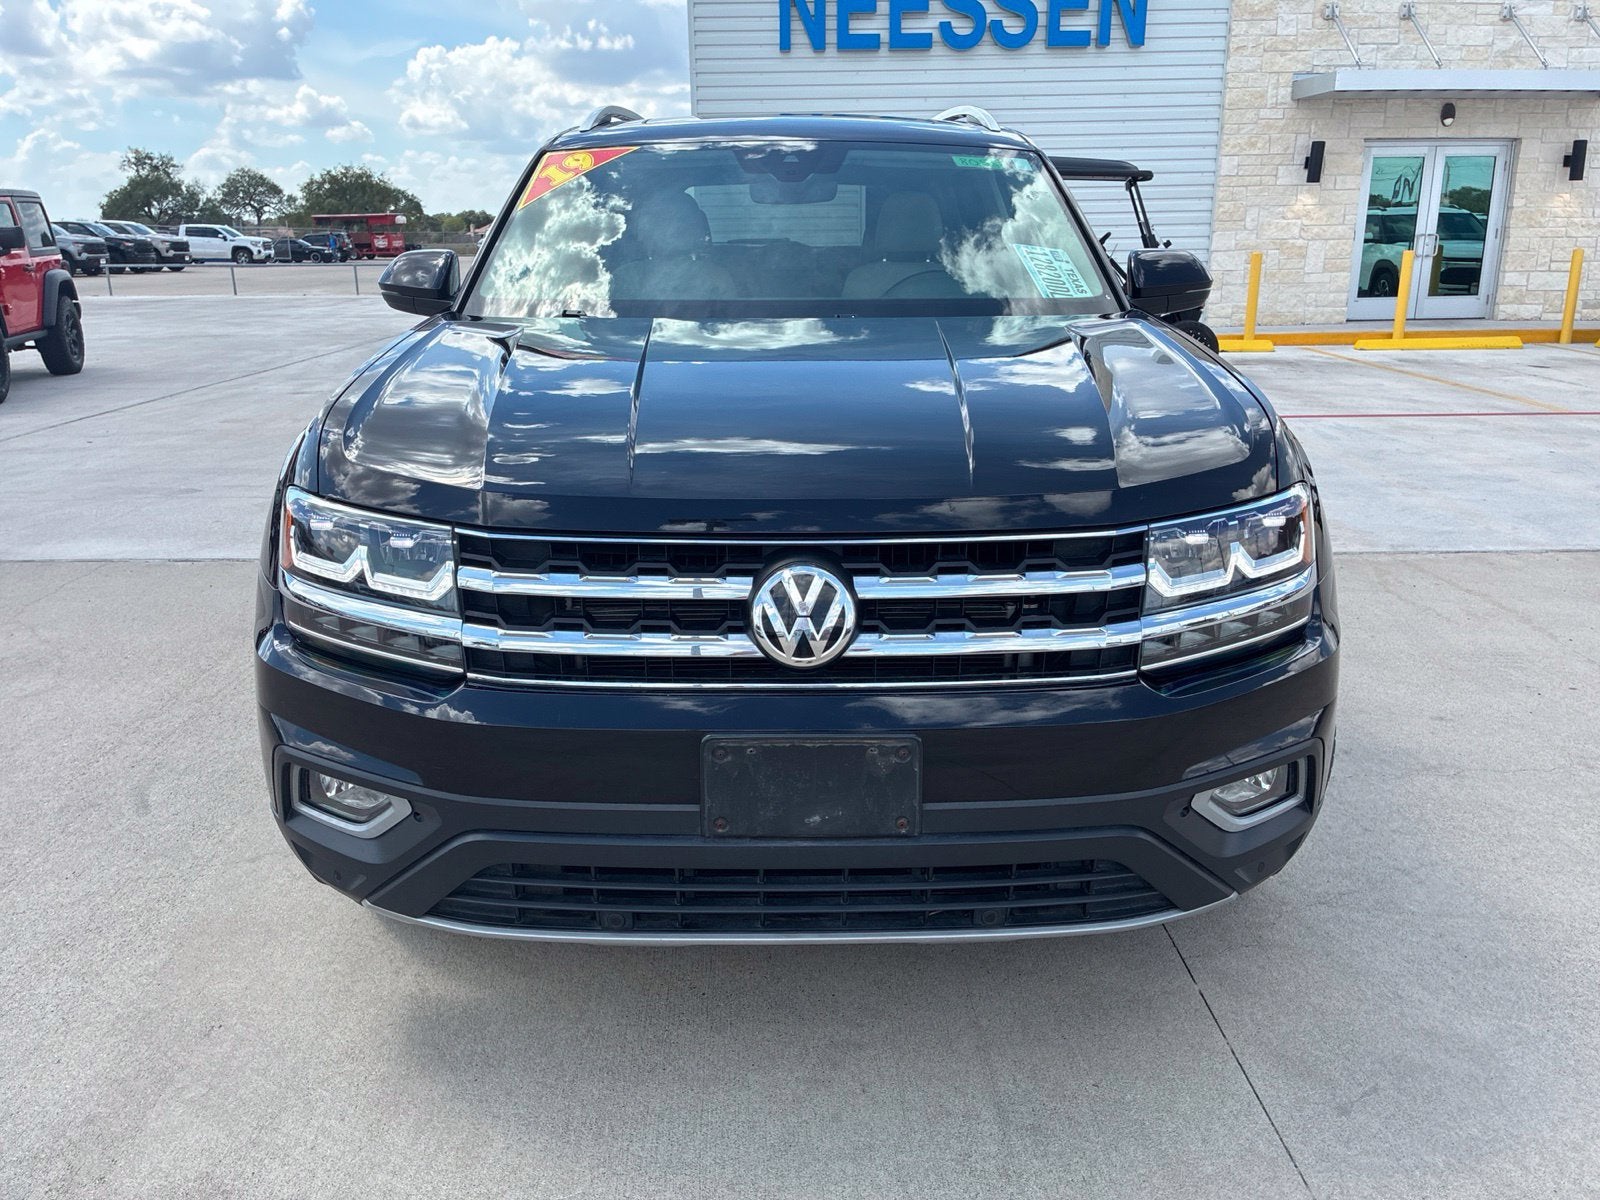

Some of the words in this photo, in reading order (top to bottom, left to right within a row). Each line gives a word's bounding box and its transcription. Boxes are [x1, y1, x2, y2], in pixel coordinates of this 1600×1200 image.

[779, 0, 1147, 53] NEESSEN
[1064, 268, 1088, 295] TEXAS
[754, 566, 855, 667] VW
